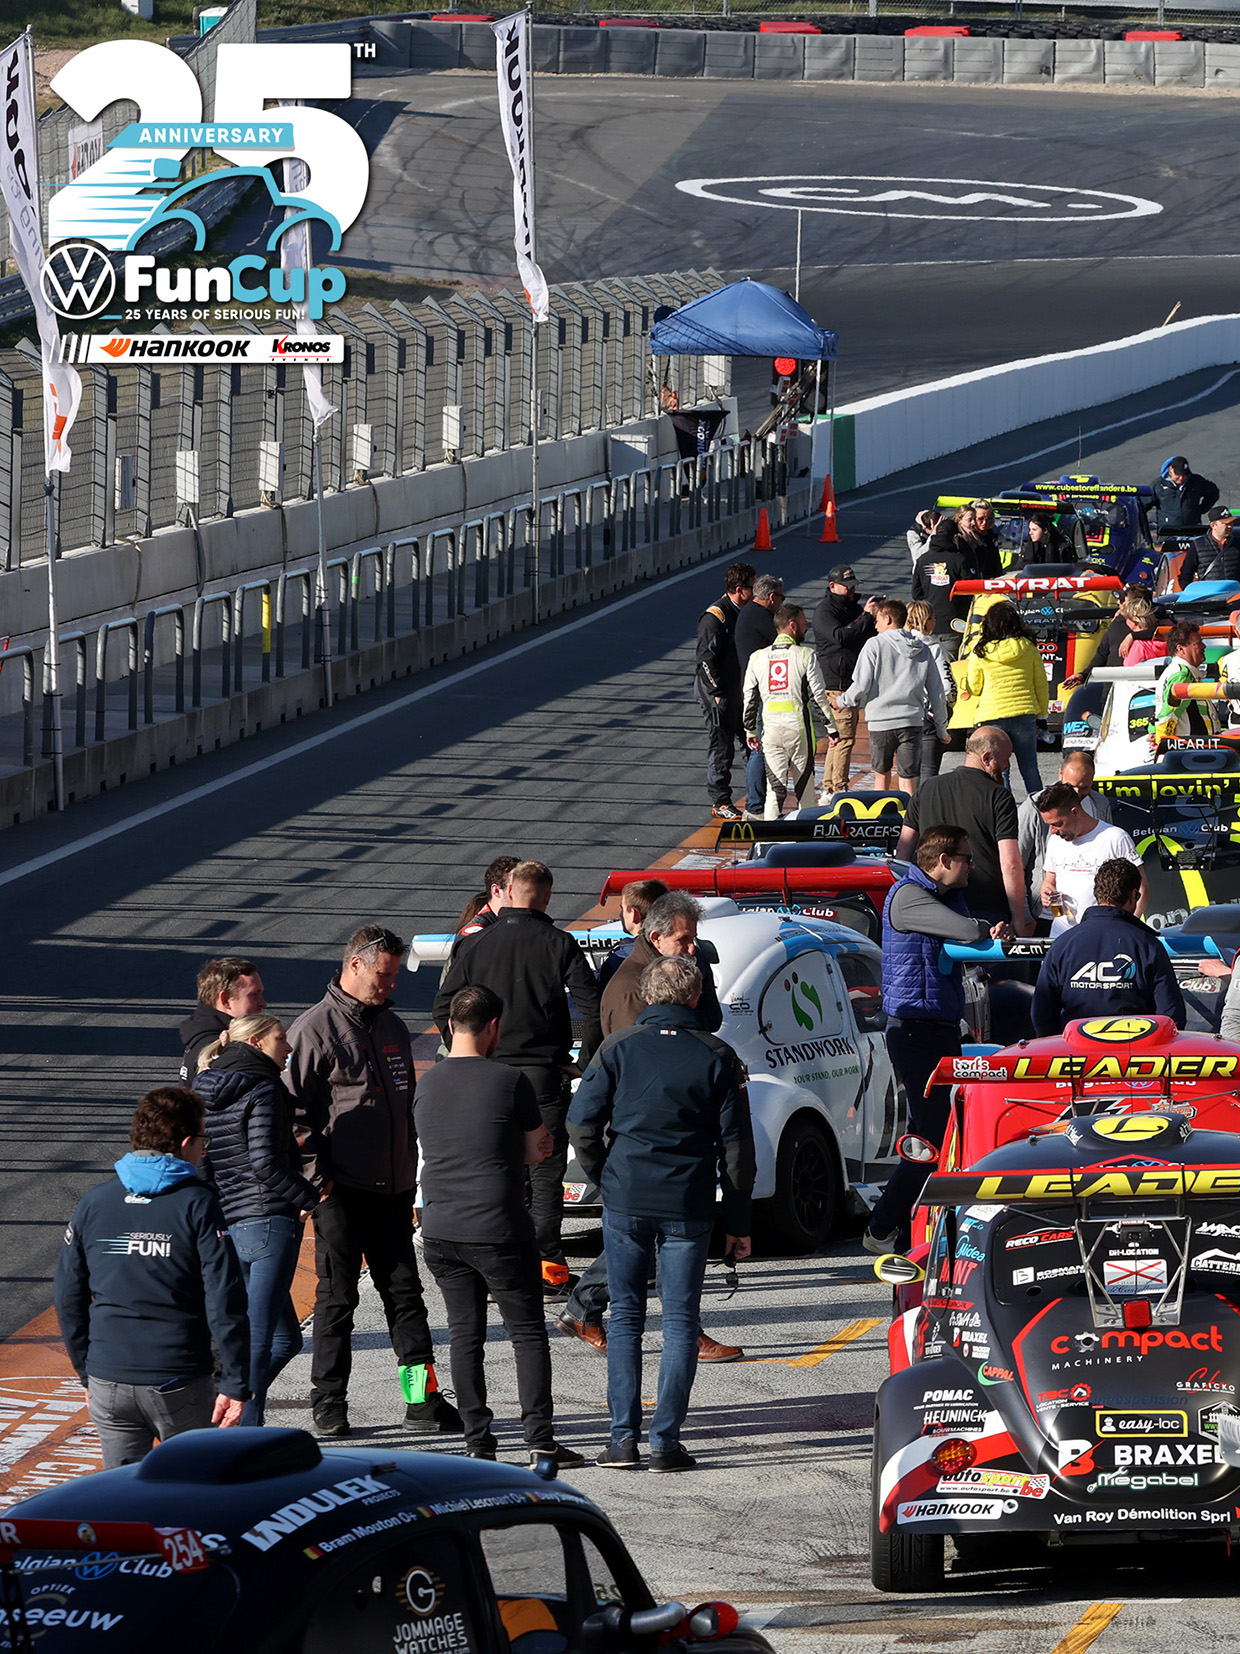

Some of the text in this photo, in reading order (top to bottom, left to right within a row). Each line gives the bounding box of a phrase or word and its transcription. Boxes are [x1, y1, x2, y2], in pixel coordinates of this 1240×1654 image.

[984, 577, 1091, 592] PYRAT
[1129, 717, 1149, 729] 365
[1167, 738, 1220, 750] WEAR IT
[1098, 780, 1141, 797] i'm
[802, 908, 834, 918] Club
[1070, 982, 1133, 990] MOTORSPORT
[1179, 979, 1212, 993] Club
[765, 1036, 855, 1069] STANDWORK
[955, 1056, 989, 1071] torfs
[1013, 1055, 1239, 1079] LEADER
[793, 1073, 811, 1084] YOUR
[812, 1070, 831, 1081] STAND,
[831, 1068, 843, 1077] OUR
[955, 1067, 1007, 1080] compact
[129, 1232, 172, 1241] SERIOUSLY
[1005, 1230, 1075, 1249] RECO CARS
[127, 1241, 171, 1257] FUN!
[1108, 1248, 1159, 1256] DH-LOCATION
[961, 1330, 988, 1344] BRAXEL
[1051, 1355, 1144, 1371] MACHINERY
[983, 1364, 1014, 1382] CAPPAL
[1176, 1381, 1236, 1392] GRAFICKO
[923, 1388, 974, 1403] POMAC
[923, 1408, 988, 1425] HEUNINCK
[1118, 1416, 1180, 1434] easy-loc
[1114, 1444, 1223, 1466] BRAXEL
[361, 1489, 401, 1506] PROJECTS
[240, 1474, 392, 1552] INDULEK
[1054, 1508, 1231, 1526] Van Roy Démolition Sprl
[318, 1532, 352, 1553] Bram
[352, 1515, 402, 1539] Mouton
[430, 1497, 470, 1515] Michiel
[163, 1529, 205, 1571] 254
[13, 1555, 174, 1579] elgian Club
[30, 1584, 77, 1595] OPTIEK
[393, 1613, 464, 1643] JOMMAGE
[395, 1631, 469, 1654] WATCHES
